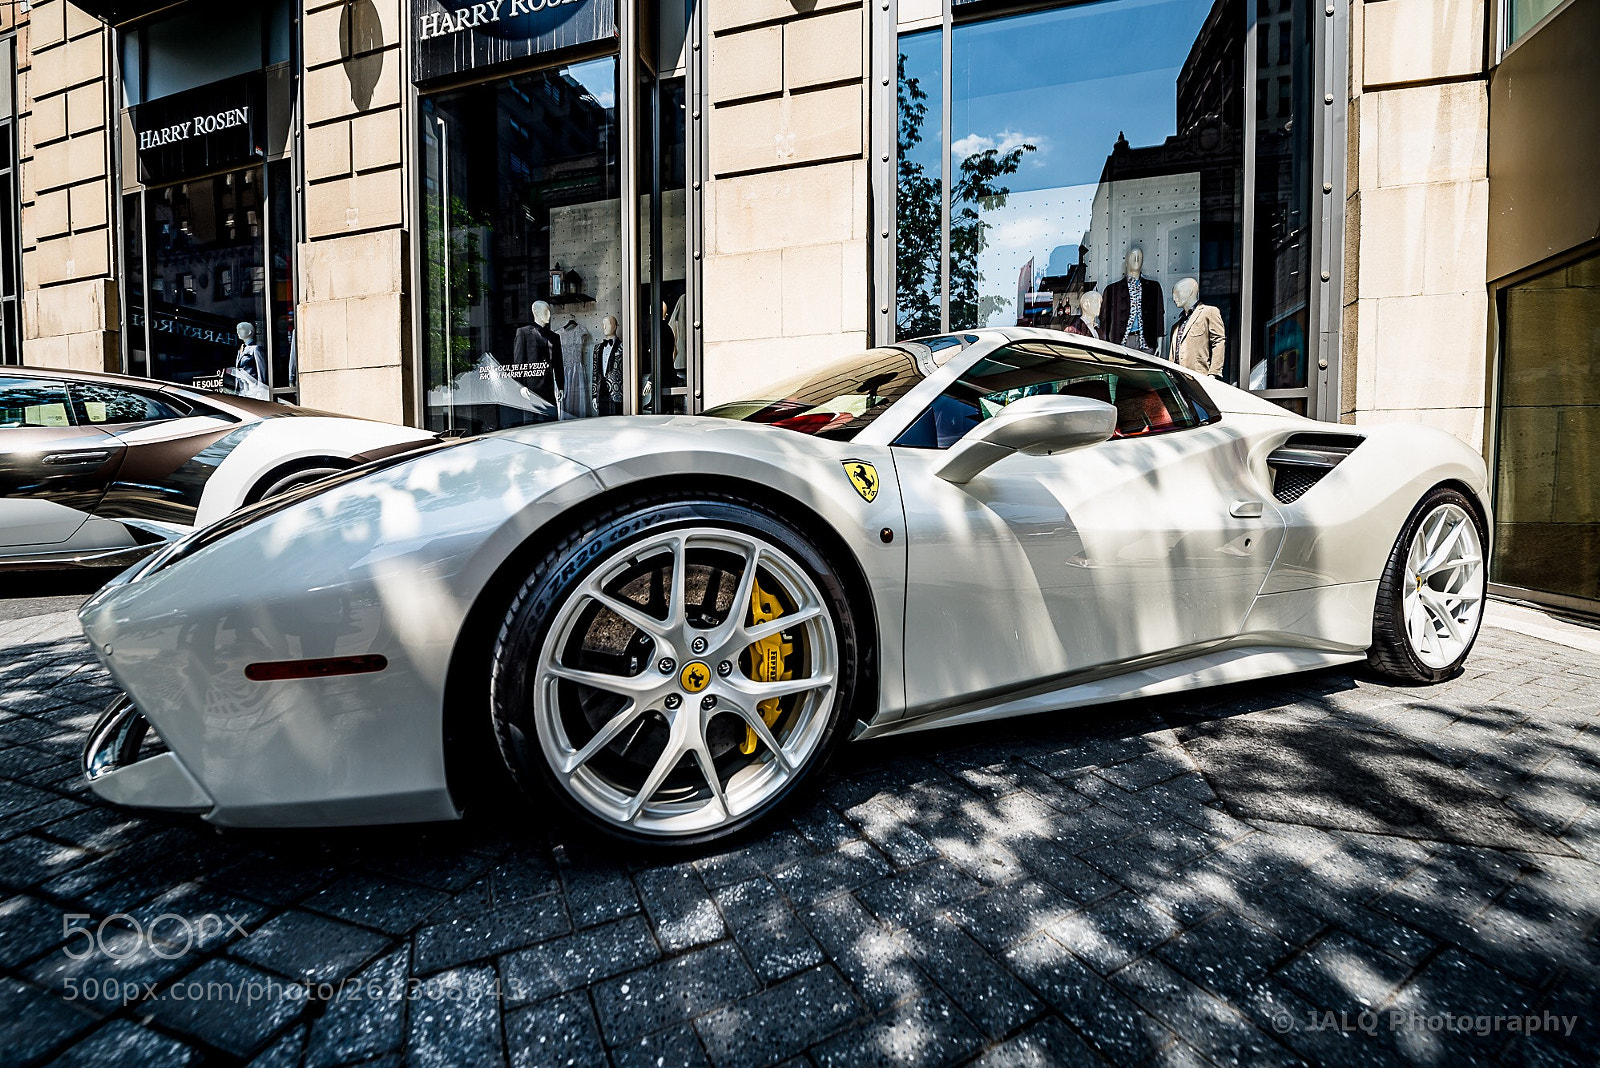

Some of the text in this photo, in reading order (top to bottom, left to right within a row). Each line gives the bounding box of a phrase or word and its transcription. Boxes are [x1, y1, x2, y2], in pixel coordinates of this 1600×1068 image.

[419, 0, 502, 40] HARRY
[139, 106, 249, 150] HARRY ROSEN
[202, 379, 223, 388] SOLDE
[523, 369, 546, 378] ROSEN
[550, 539, 603, 597] ZR20
